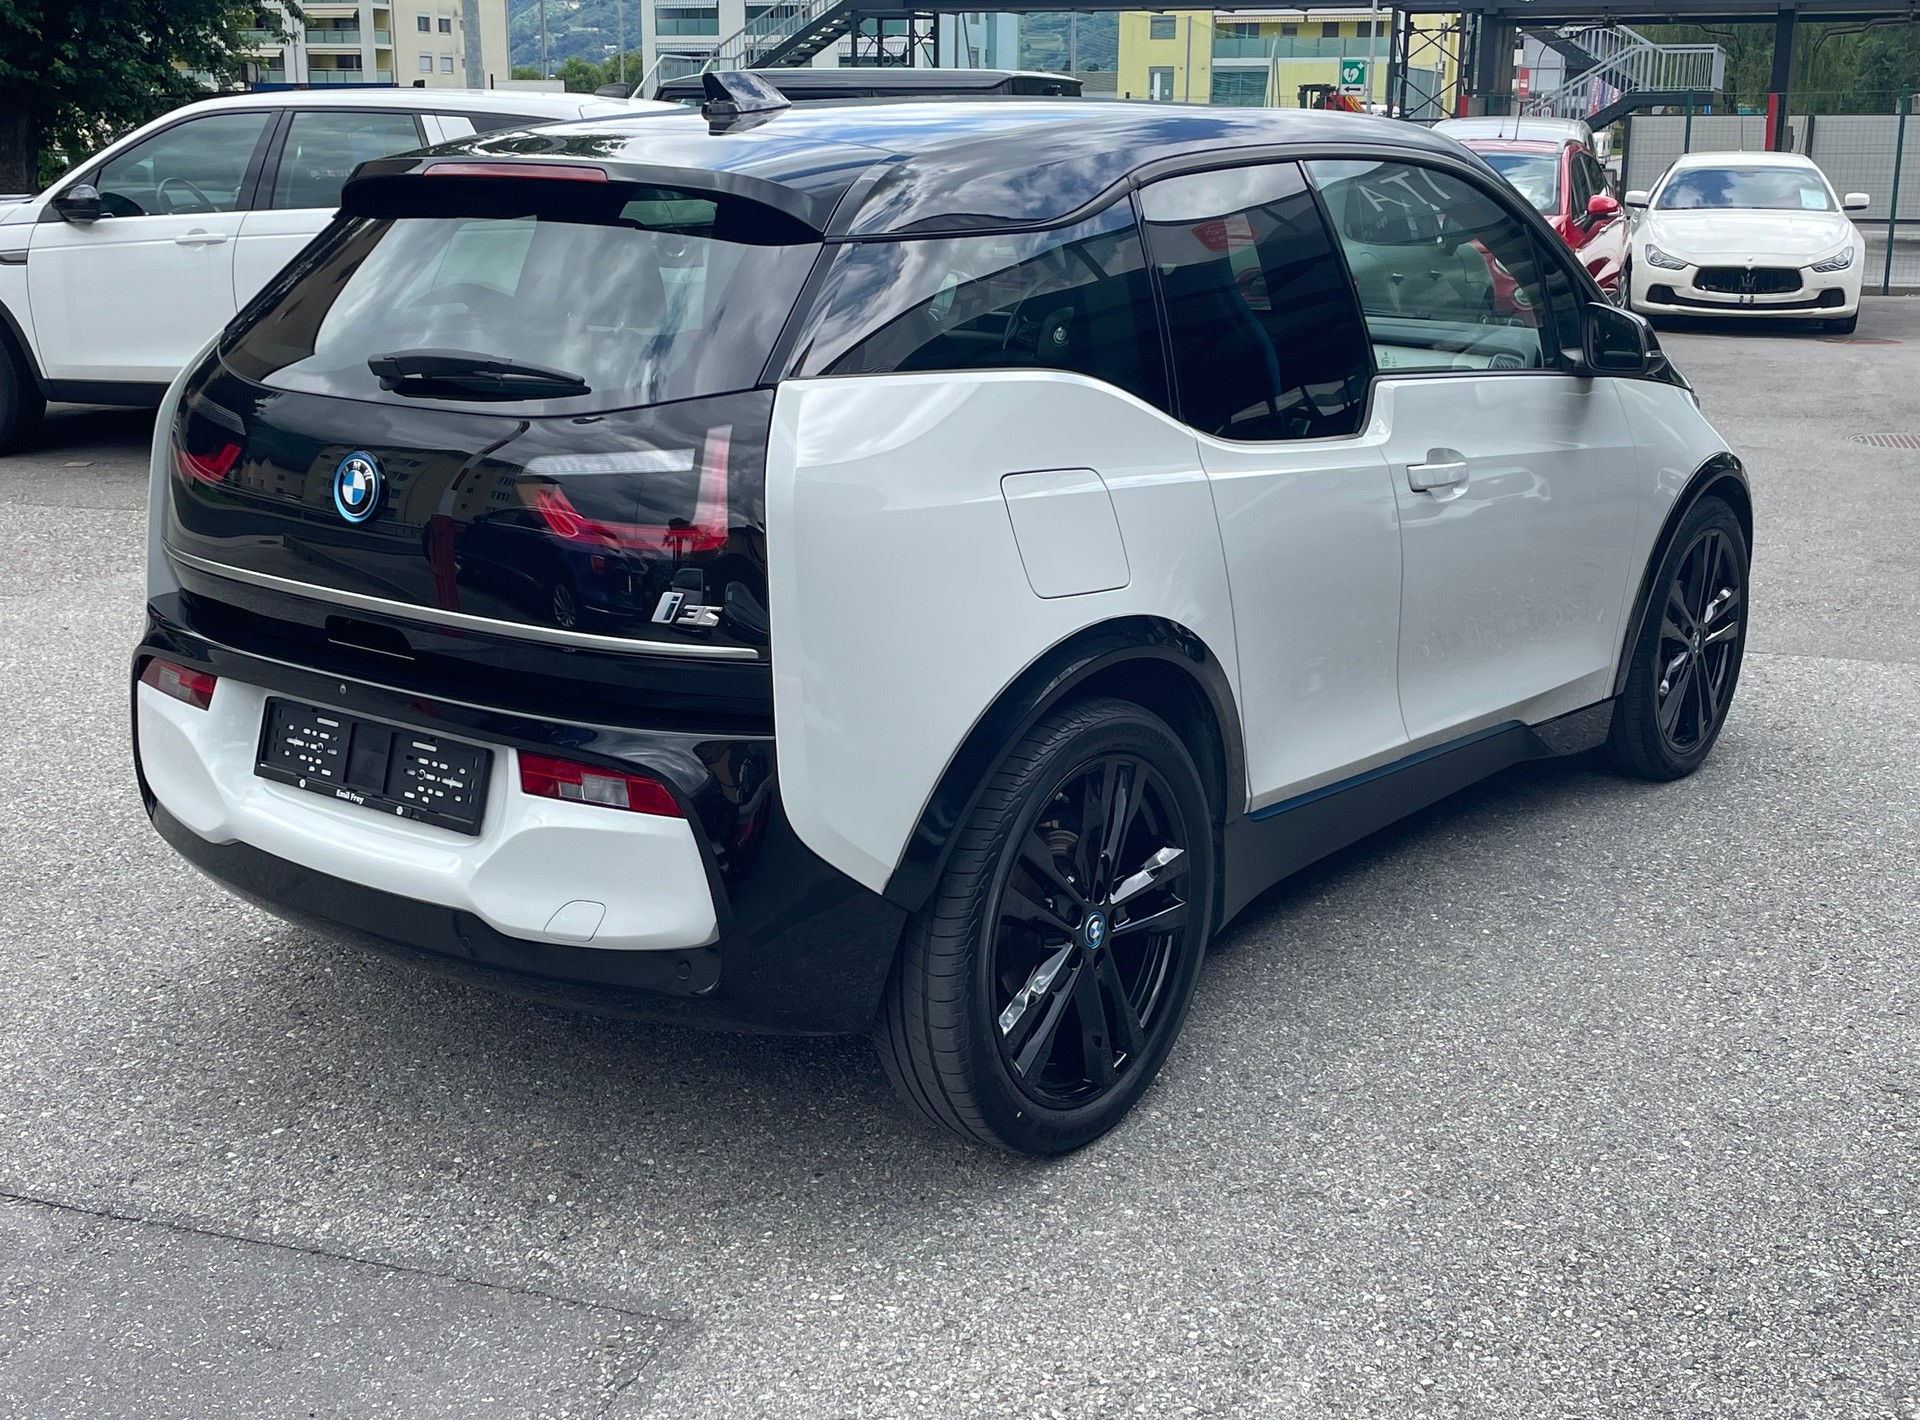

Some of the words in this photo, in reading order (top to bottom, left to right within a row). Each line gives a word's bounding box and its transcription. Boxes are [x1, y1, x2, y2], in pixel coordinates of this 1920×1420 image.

[342, 461, 372, 481] BMW
[336, 789, 350, 799] Emil
[350, 793, 364, 804] Frey
